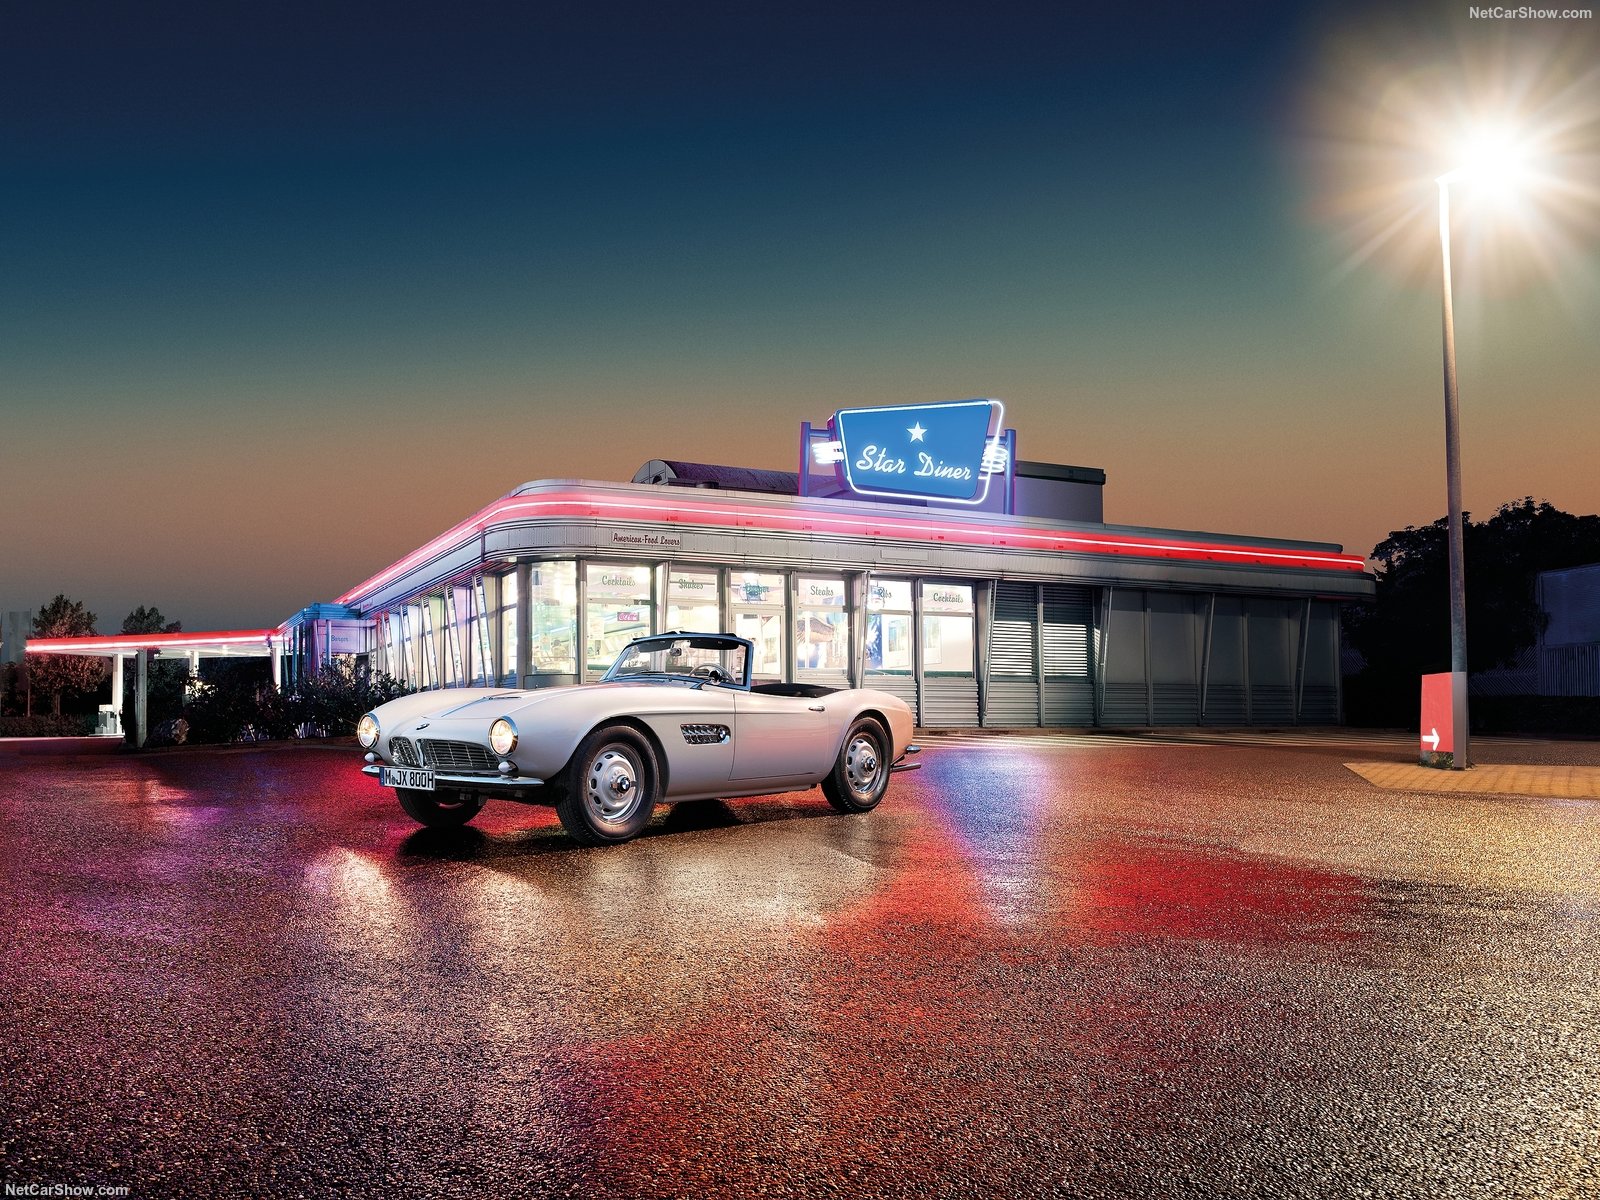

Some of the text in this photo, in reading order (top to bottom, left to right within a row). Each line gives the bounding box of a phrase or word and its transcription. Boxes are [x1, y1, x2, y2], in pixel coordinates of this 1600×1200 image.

[856, 445, 971, 480] Star Diner
[660, 536, 680, 545] Lovers
[601, 575, 636, 587] Cocktails
[810, 585, 834, 596] Steaks
[933, 592, 964, 604] Cocktails
[409, 771, 434, 789] 800H
